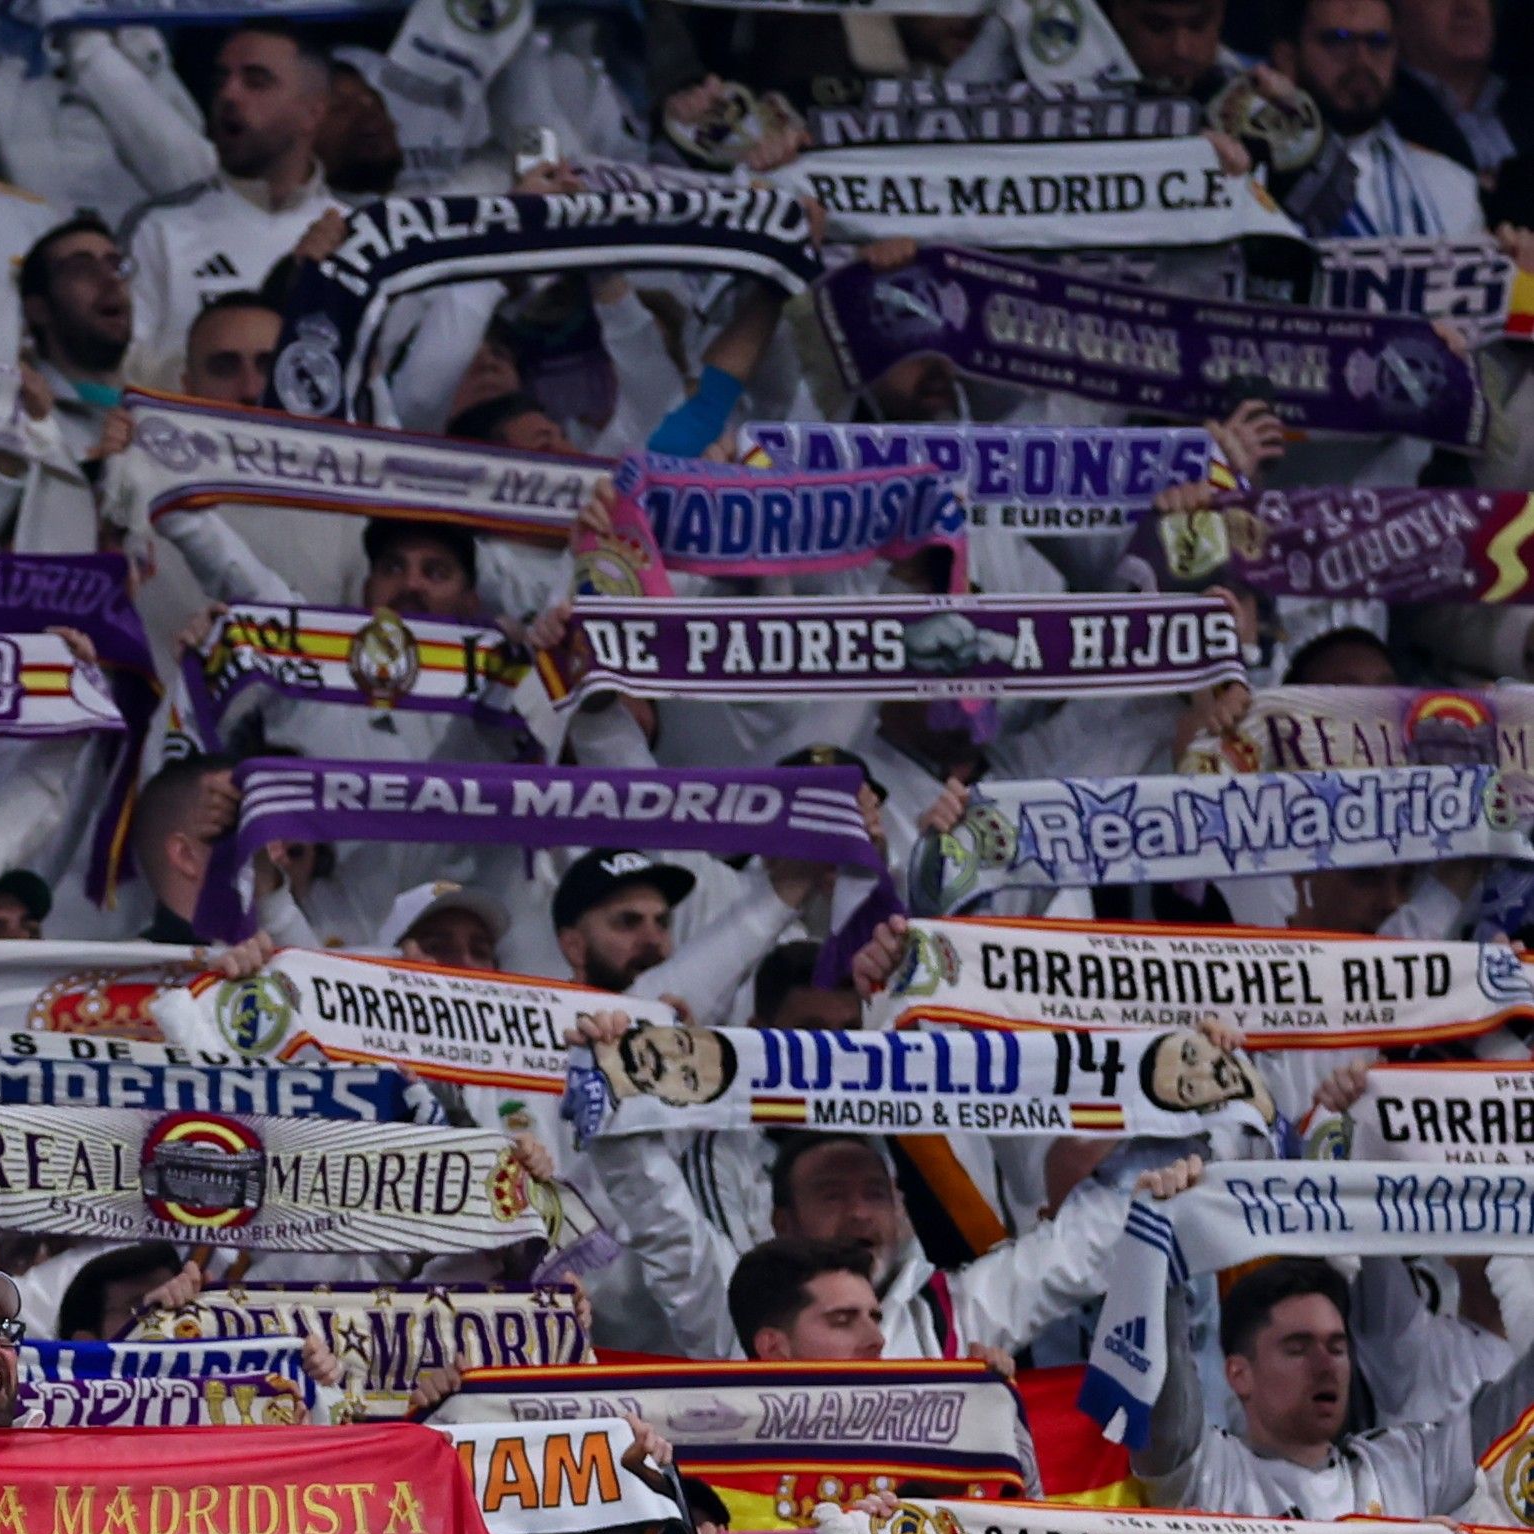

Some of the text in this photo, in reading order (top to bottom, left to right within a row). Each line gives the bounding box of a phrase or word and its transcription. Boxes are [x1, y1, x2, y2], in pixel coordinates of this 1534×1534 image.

[810, 167, 1234, 215] REAL MADRID C.F.
[756, 428, 1212, 498] CAMPEONES
[1004, 505, 1126, 529] EUROPA
[584, 612, 1241, 676] DE PADRES A HIJOS
[1267, 713, 1410, 769] REAL
[321, 770, 788, 826] REAL MADRID
[1033, 769, 1483, 864] Real Madrid
[982, 944, 1454, 1006] CARABANCHEL ALTO
[312, 976, 572, 1052] CARABANCHEL
[1041, 1002, 1113, 1024] HALA
[1264, 1009, 1334, 1029] NADA
[70, 1038, 132, 1061] DE
[1055, 1031, 1127, 1097] 14
[815, 1097, 1068, 1129] MADRID & ESPAÑA
[266, 1149, 472, 1215] MADRID
[1228, 1177, 1357, 1237] REAL
[48, 1196, 353, 1242] ESTADIO SANTIAGO BERNABEU
[365, 1300, 589, 1366] MADRID
[760, 1391, 968, 1445] MADRID
